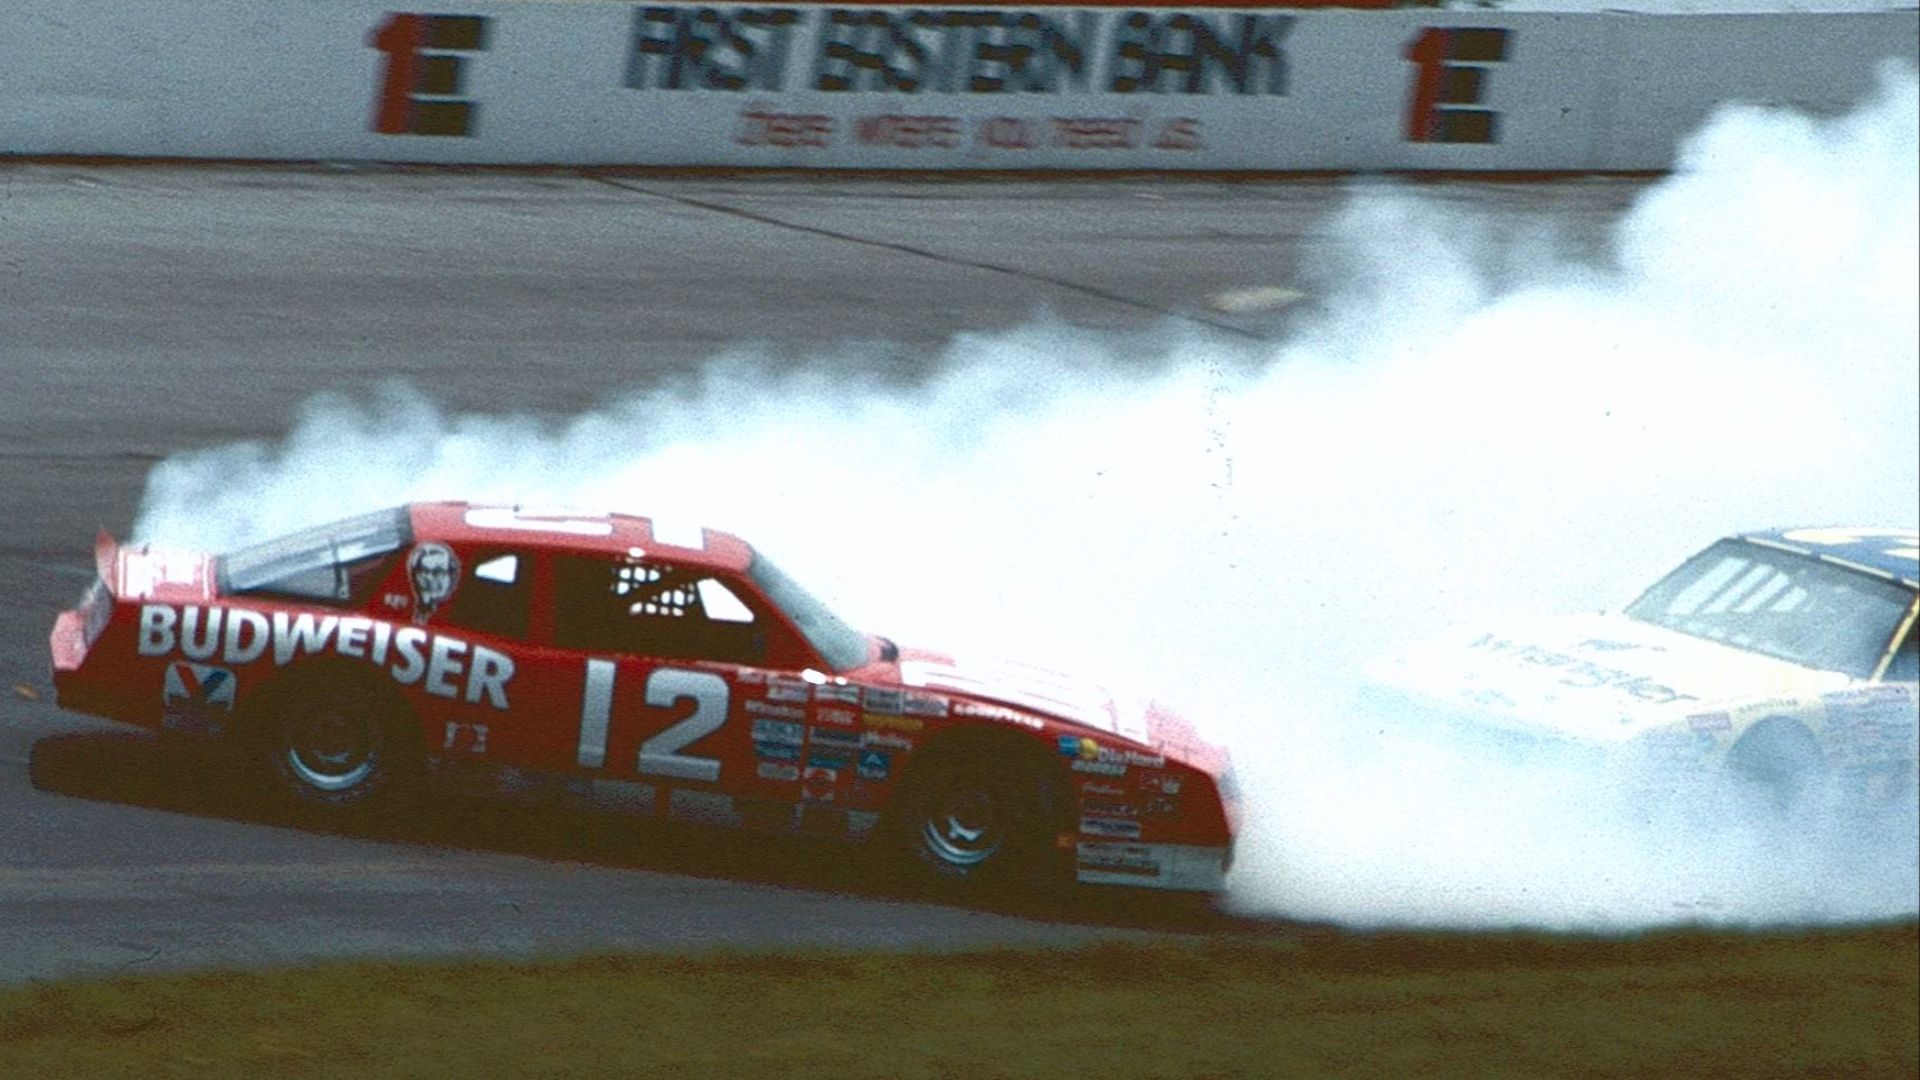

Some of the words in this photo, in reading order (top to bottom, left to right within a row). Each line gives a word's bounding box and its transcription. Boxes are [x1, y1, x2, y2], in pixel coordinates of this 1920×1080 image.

[1105, 13, 1295, 96] BANK
[138, 604, 516, 711] BUDWEISER
[577, 658, 730, 781] 12
